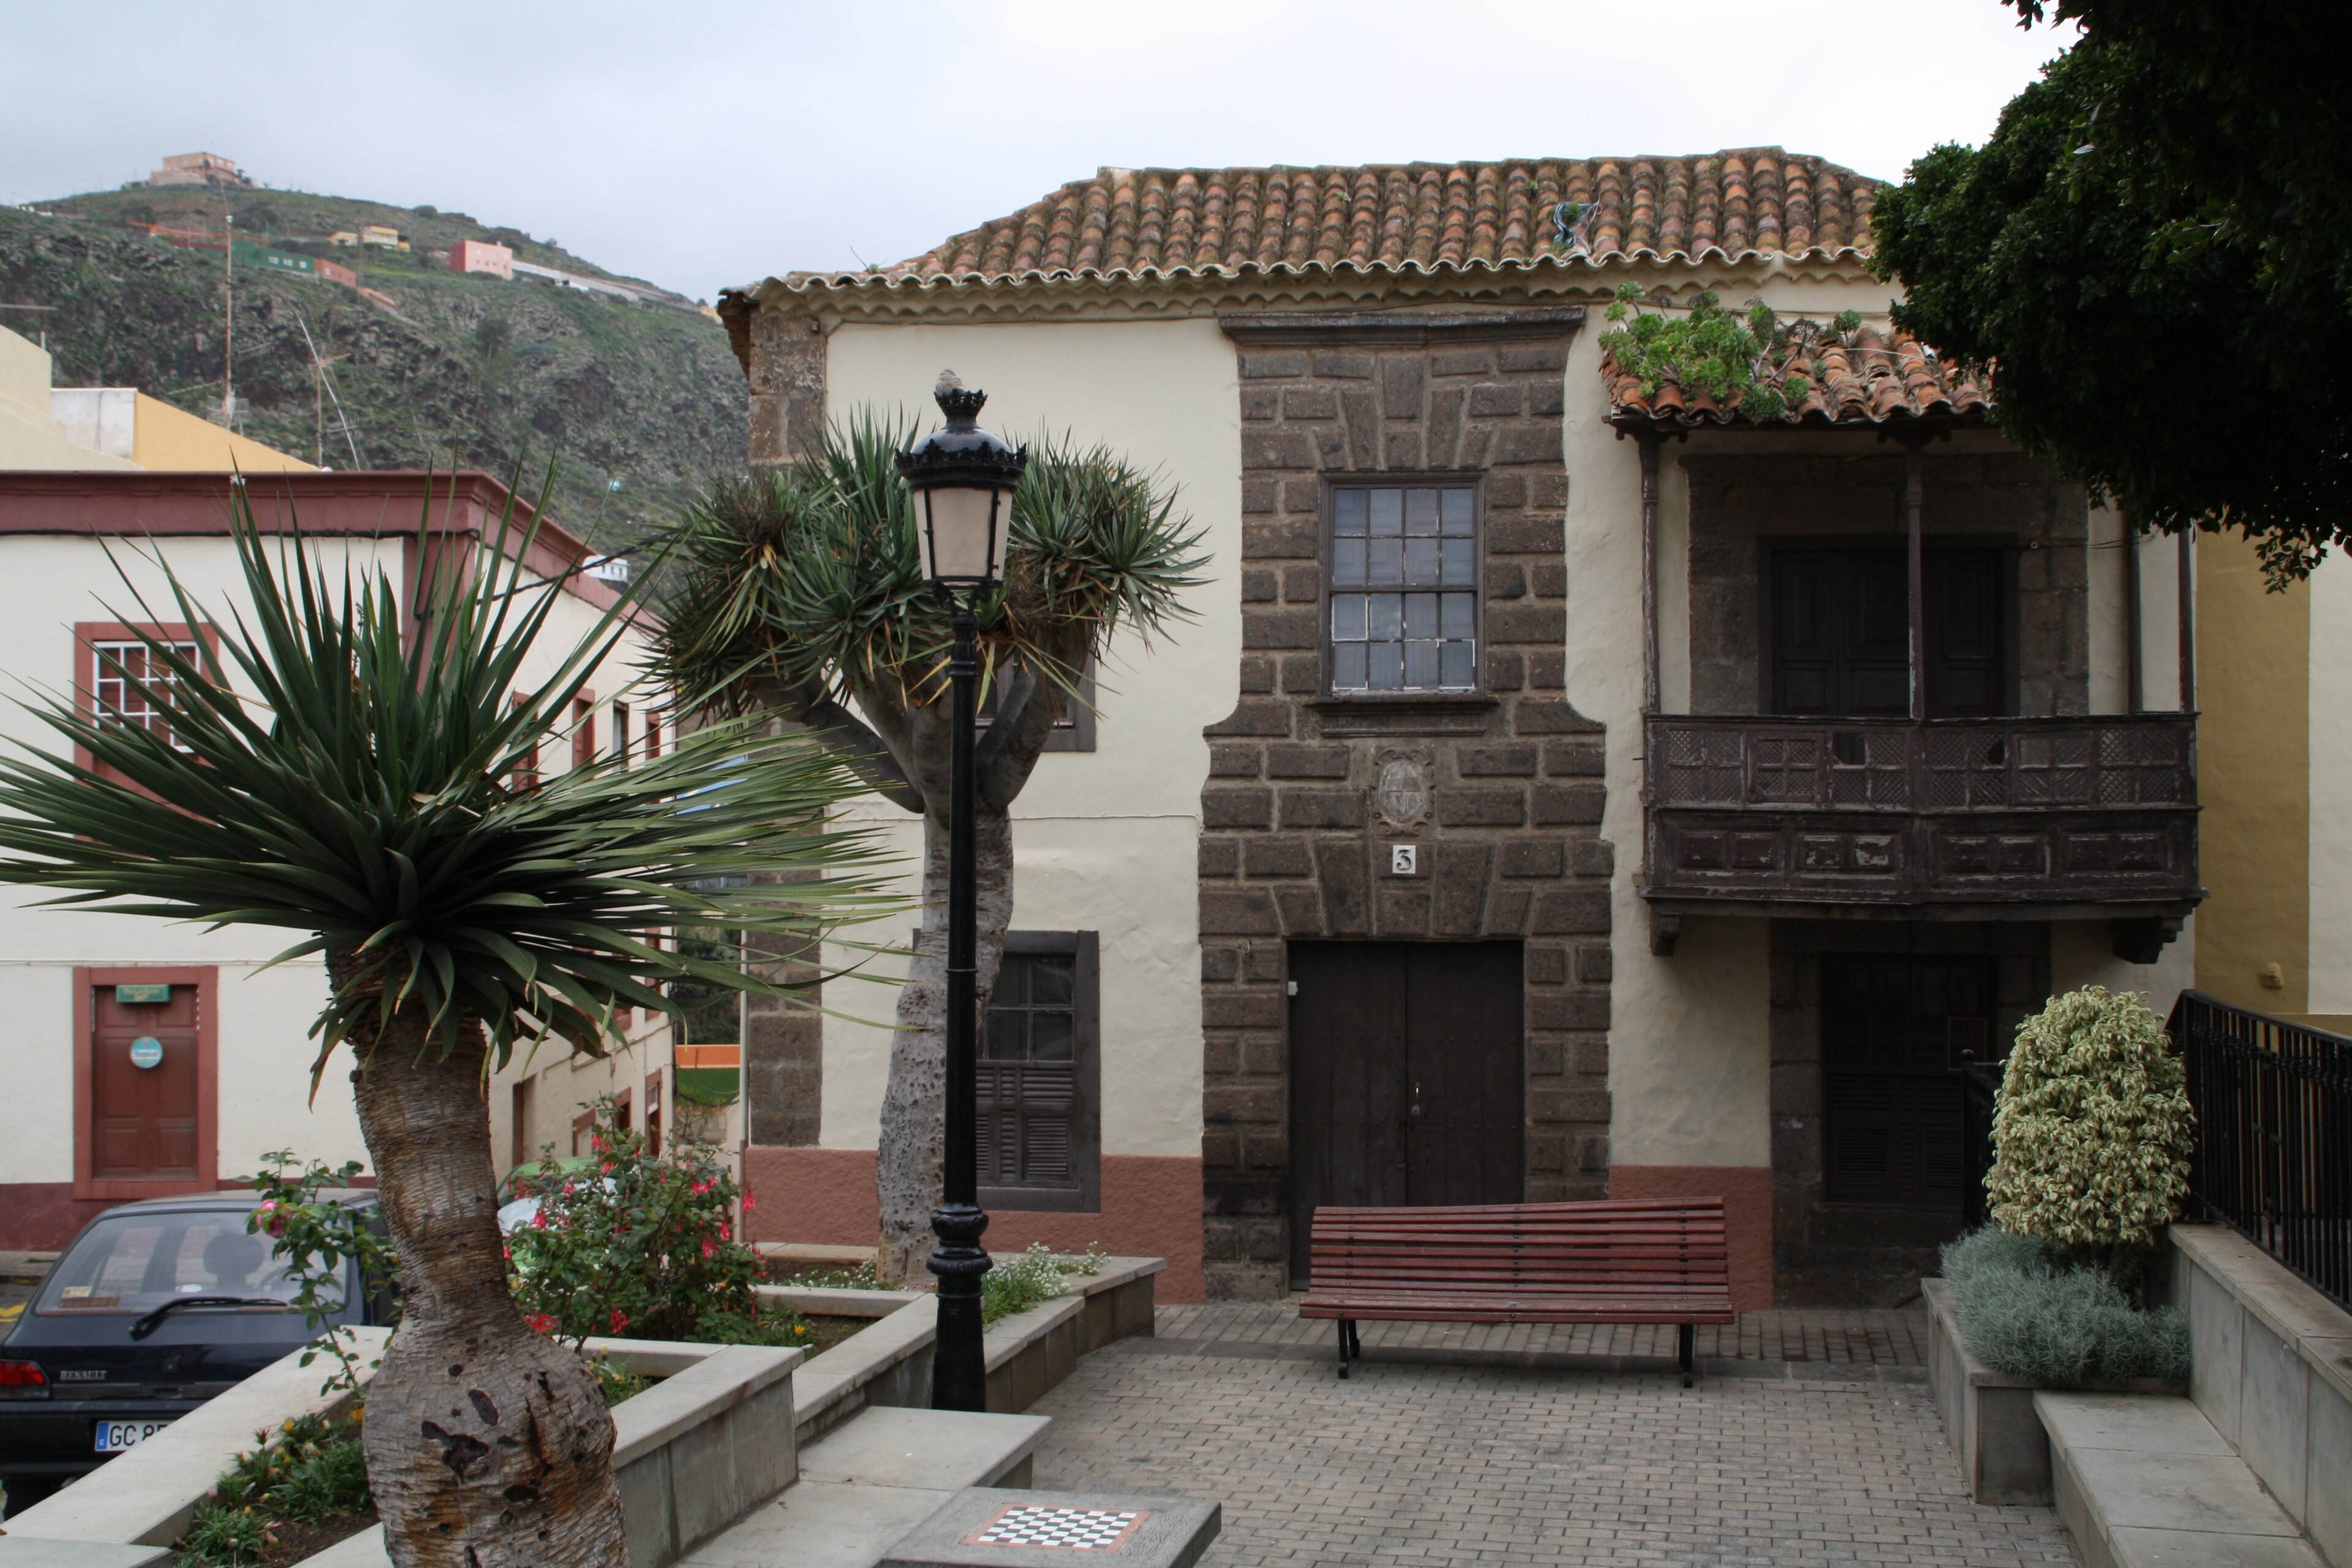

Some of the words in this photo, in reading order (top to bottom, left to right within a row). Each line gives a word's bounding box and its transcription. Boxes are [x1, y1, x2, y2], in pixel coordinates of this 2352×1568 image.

[1396, 849, 1412, 871] 3
[60, 1370, 107, 1381] RENAULT
[110, 1425, 136, 1446] GC
